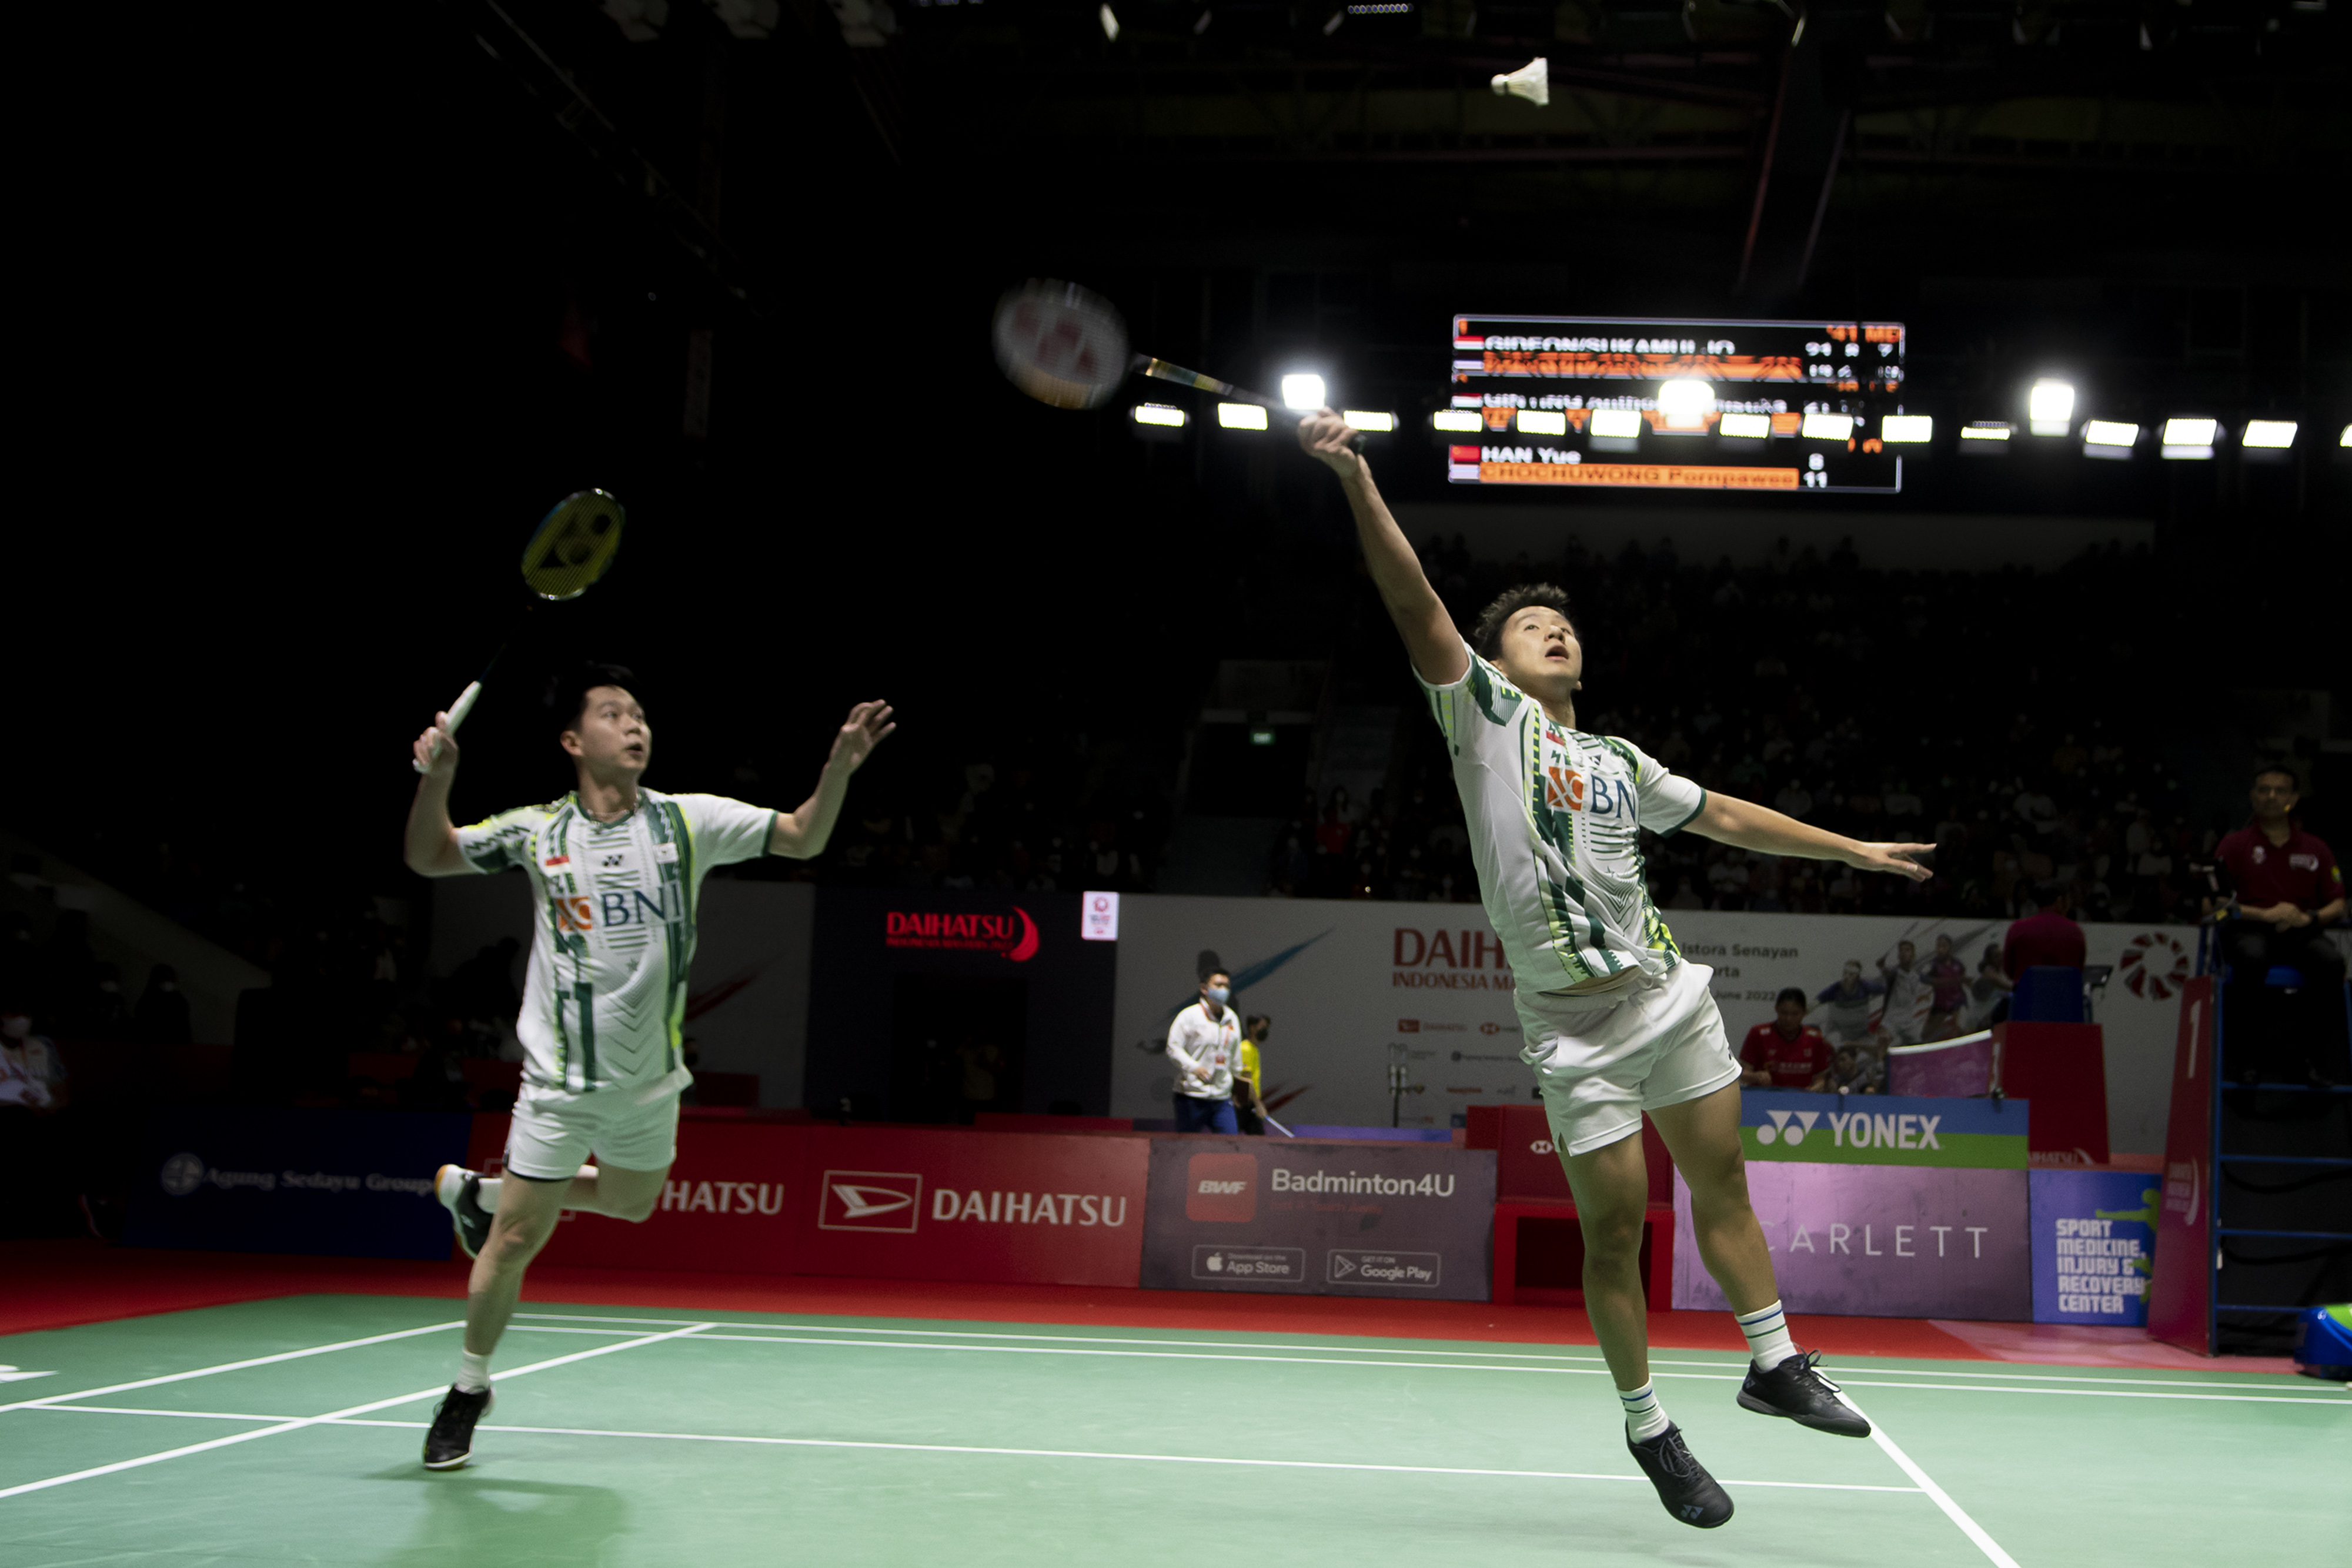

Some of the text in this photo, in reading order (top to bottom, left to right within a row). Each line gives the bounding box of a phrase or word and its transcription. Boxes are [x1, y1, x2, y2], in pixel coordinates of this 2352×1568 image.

[1481, 446, 1533, 463] HAN
[1536, 447, 1582, 464] Yue
[1803, 471, 1828, 488] 11
[602, 883, 682, 927] BNI
[886, 912, 1014, 940] DAIHATSU
[1394, 928, 1512, 969] DAIH
[1681, 942, 1799, 959] Istora Senayan
[1392, 972, 1489, 990] INDONESIA
[2187, 999, 2202, 1079] 1
[1828, 1112, 1940, 1150] YONEX
[204, 1166, 435, 1197] Agung Sedayu Group
[1198, 1179, 1247, 1195] BWF
[1271, 1168, 1456, 1198] Badminton4U
[654, 1179, 786, 1216] HATSU
[932, 1188, 1127, 1228] DAIHATSU
[2055, 1218, 2113, 1238] SPORT
[2056, 1238, 2147, 1260] MEDICINE,
[1227, 1260, 1290, 1275] App Store
[1360, 1264, 1432, 1282] Google Play
[2057, 1256, 2119, 1275] INJURY
[2058, 1275, 2146, 1295] RECOVERY
[2059, 1294, 2124, 1314] CENTER
